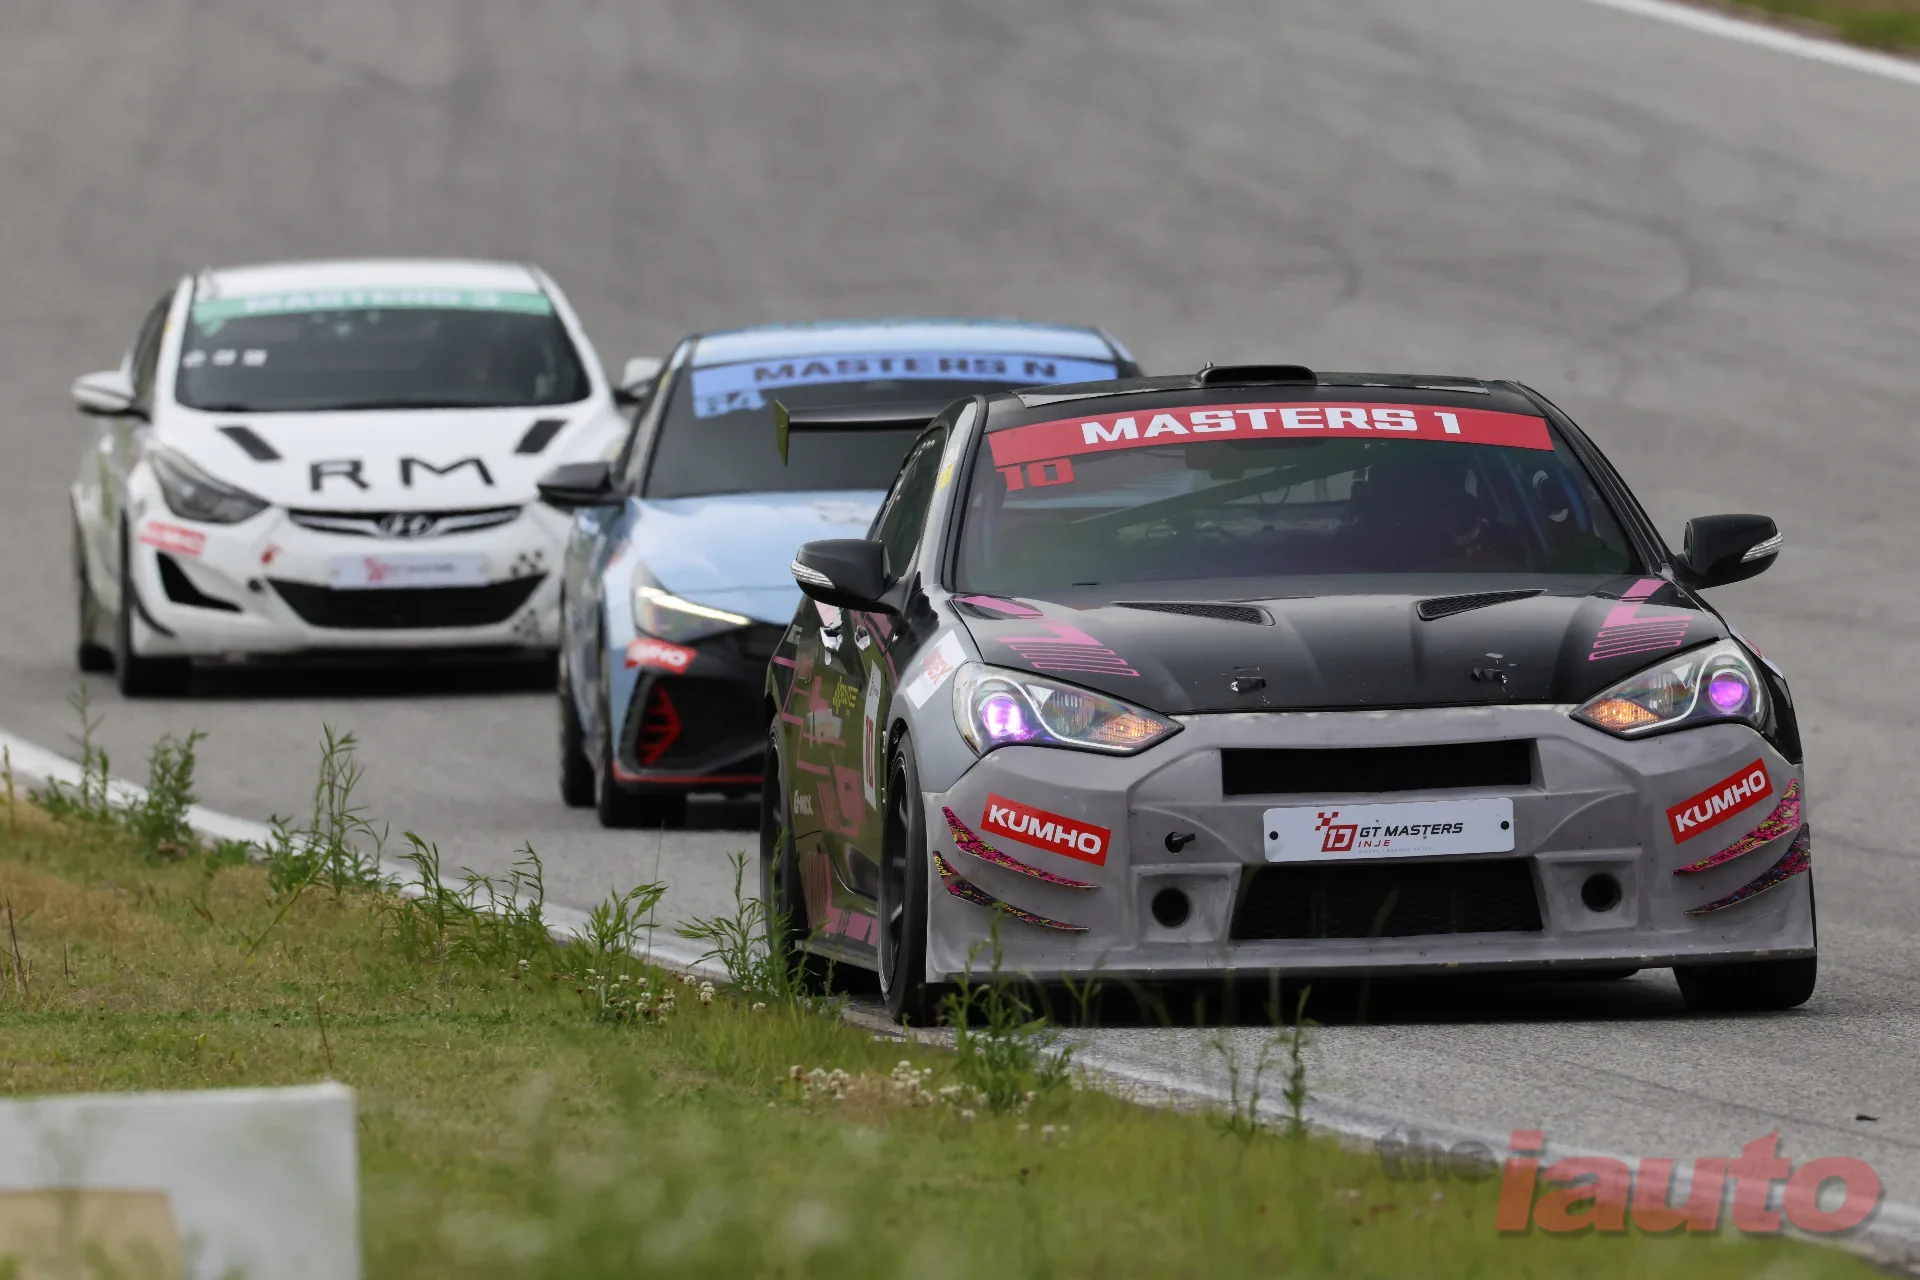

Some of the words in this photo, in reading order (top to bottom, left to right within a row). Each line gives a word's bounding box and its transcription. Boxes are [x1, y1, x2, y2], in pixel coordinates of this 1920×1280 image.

[753, 356, 1006, 382] MASTERS
[1024, 360, 1058, 378] N
[1081, 407, 1418, 445] MASTERS
[1434, 411, 1461, 435] 1
[997, 458, 1075, 492] 10
[1675, 770, 1766, 832] KUMHO
[988, 804, 1102, 855] KUMHO
[1358, 839, 1391, 848] INJE
[1359, 826, 1381, 838] GT
[1384, 822, 1463, 837] MASTERS
